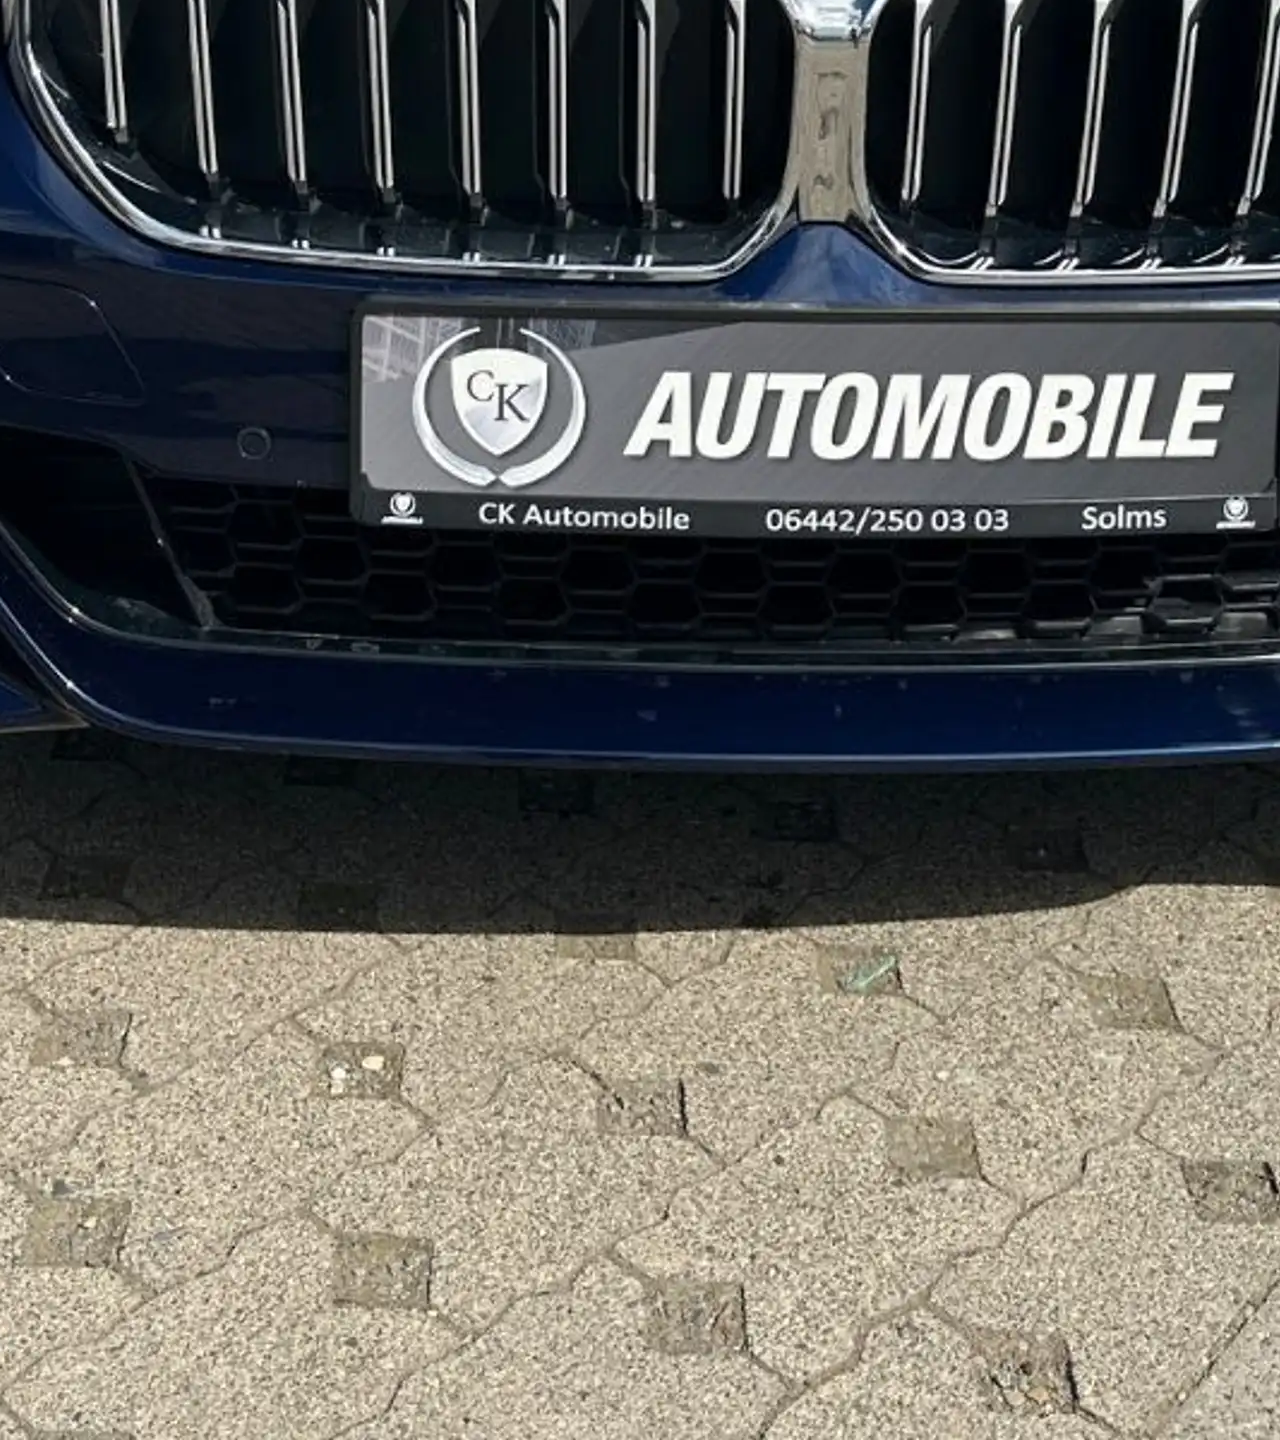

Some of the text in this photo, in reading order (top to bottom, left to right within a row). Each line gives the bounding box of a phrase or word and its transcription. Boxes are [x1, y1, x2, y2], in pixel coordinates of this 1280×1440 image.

[466, 369, 530, 422] CK
[623, 370, 1234, 460] AUTOMOBILE
[478, 502, 1168, 536] CK Automobile 06442/250 03 03 Solms
